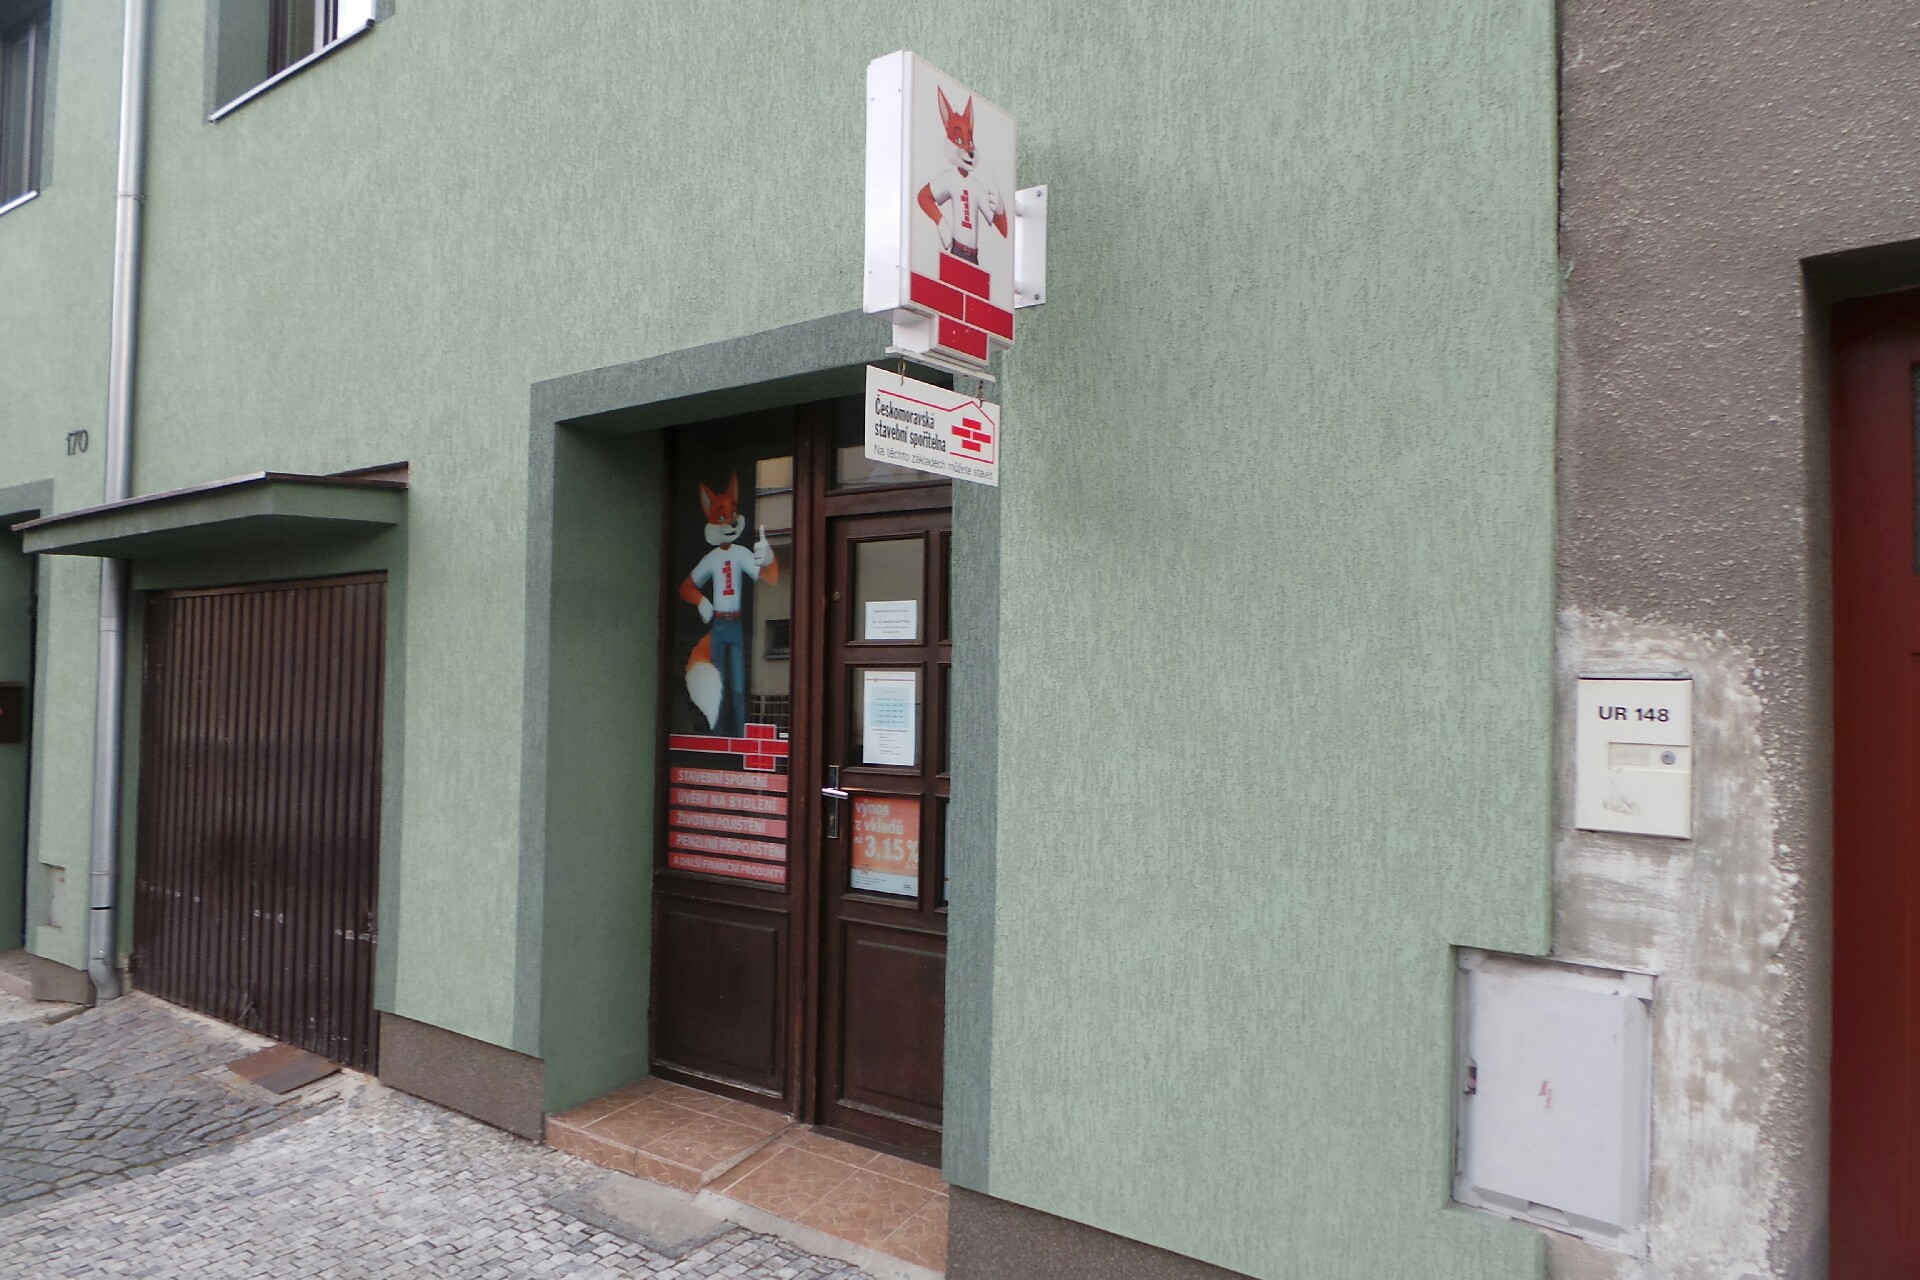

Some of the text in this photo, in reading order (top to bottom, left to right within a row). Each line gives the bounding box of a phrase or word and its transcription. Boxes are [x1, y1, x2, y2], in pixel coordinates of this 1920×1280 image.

[875, 394, 935, 430] Českomoravská
[66, 429, 89, 456] 170
[874, 420, 947, 453] stavební spořitelna
[873, 444, 885, 456] Na
[886, 448, 910, 462] těchto
[911, 454, 947, 470] základech
[947, 462, 972, 475] můžete
[1598, 706, 1670, 722] UR 148
[678, 769, 768, 788] STAVEBNÍ SPOŘENÍ
[677, 789, 777, 812] ÚVĚRY NA BYDLENÍ
[855, 800, 890, 817] výnos
[676, 810, 715, 826] ŽIVOTNÍ
[854, 820, 861, 831] z
